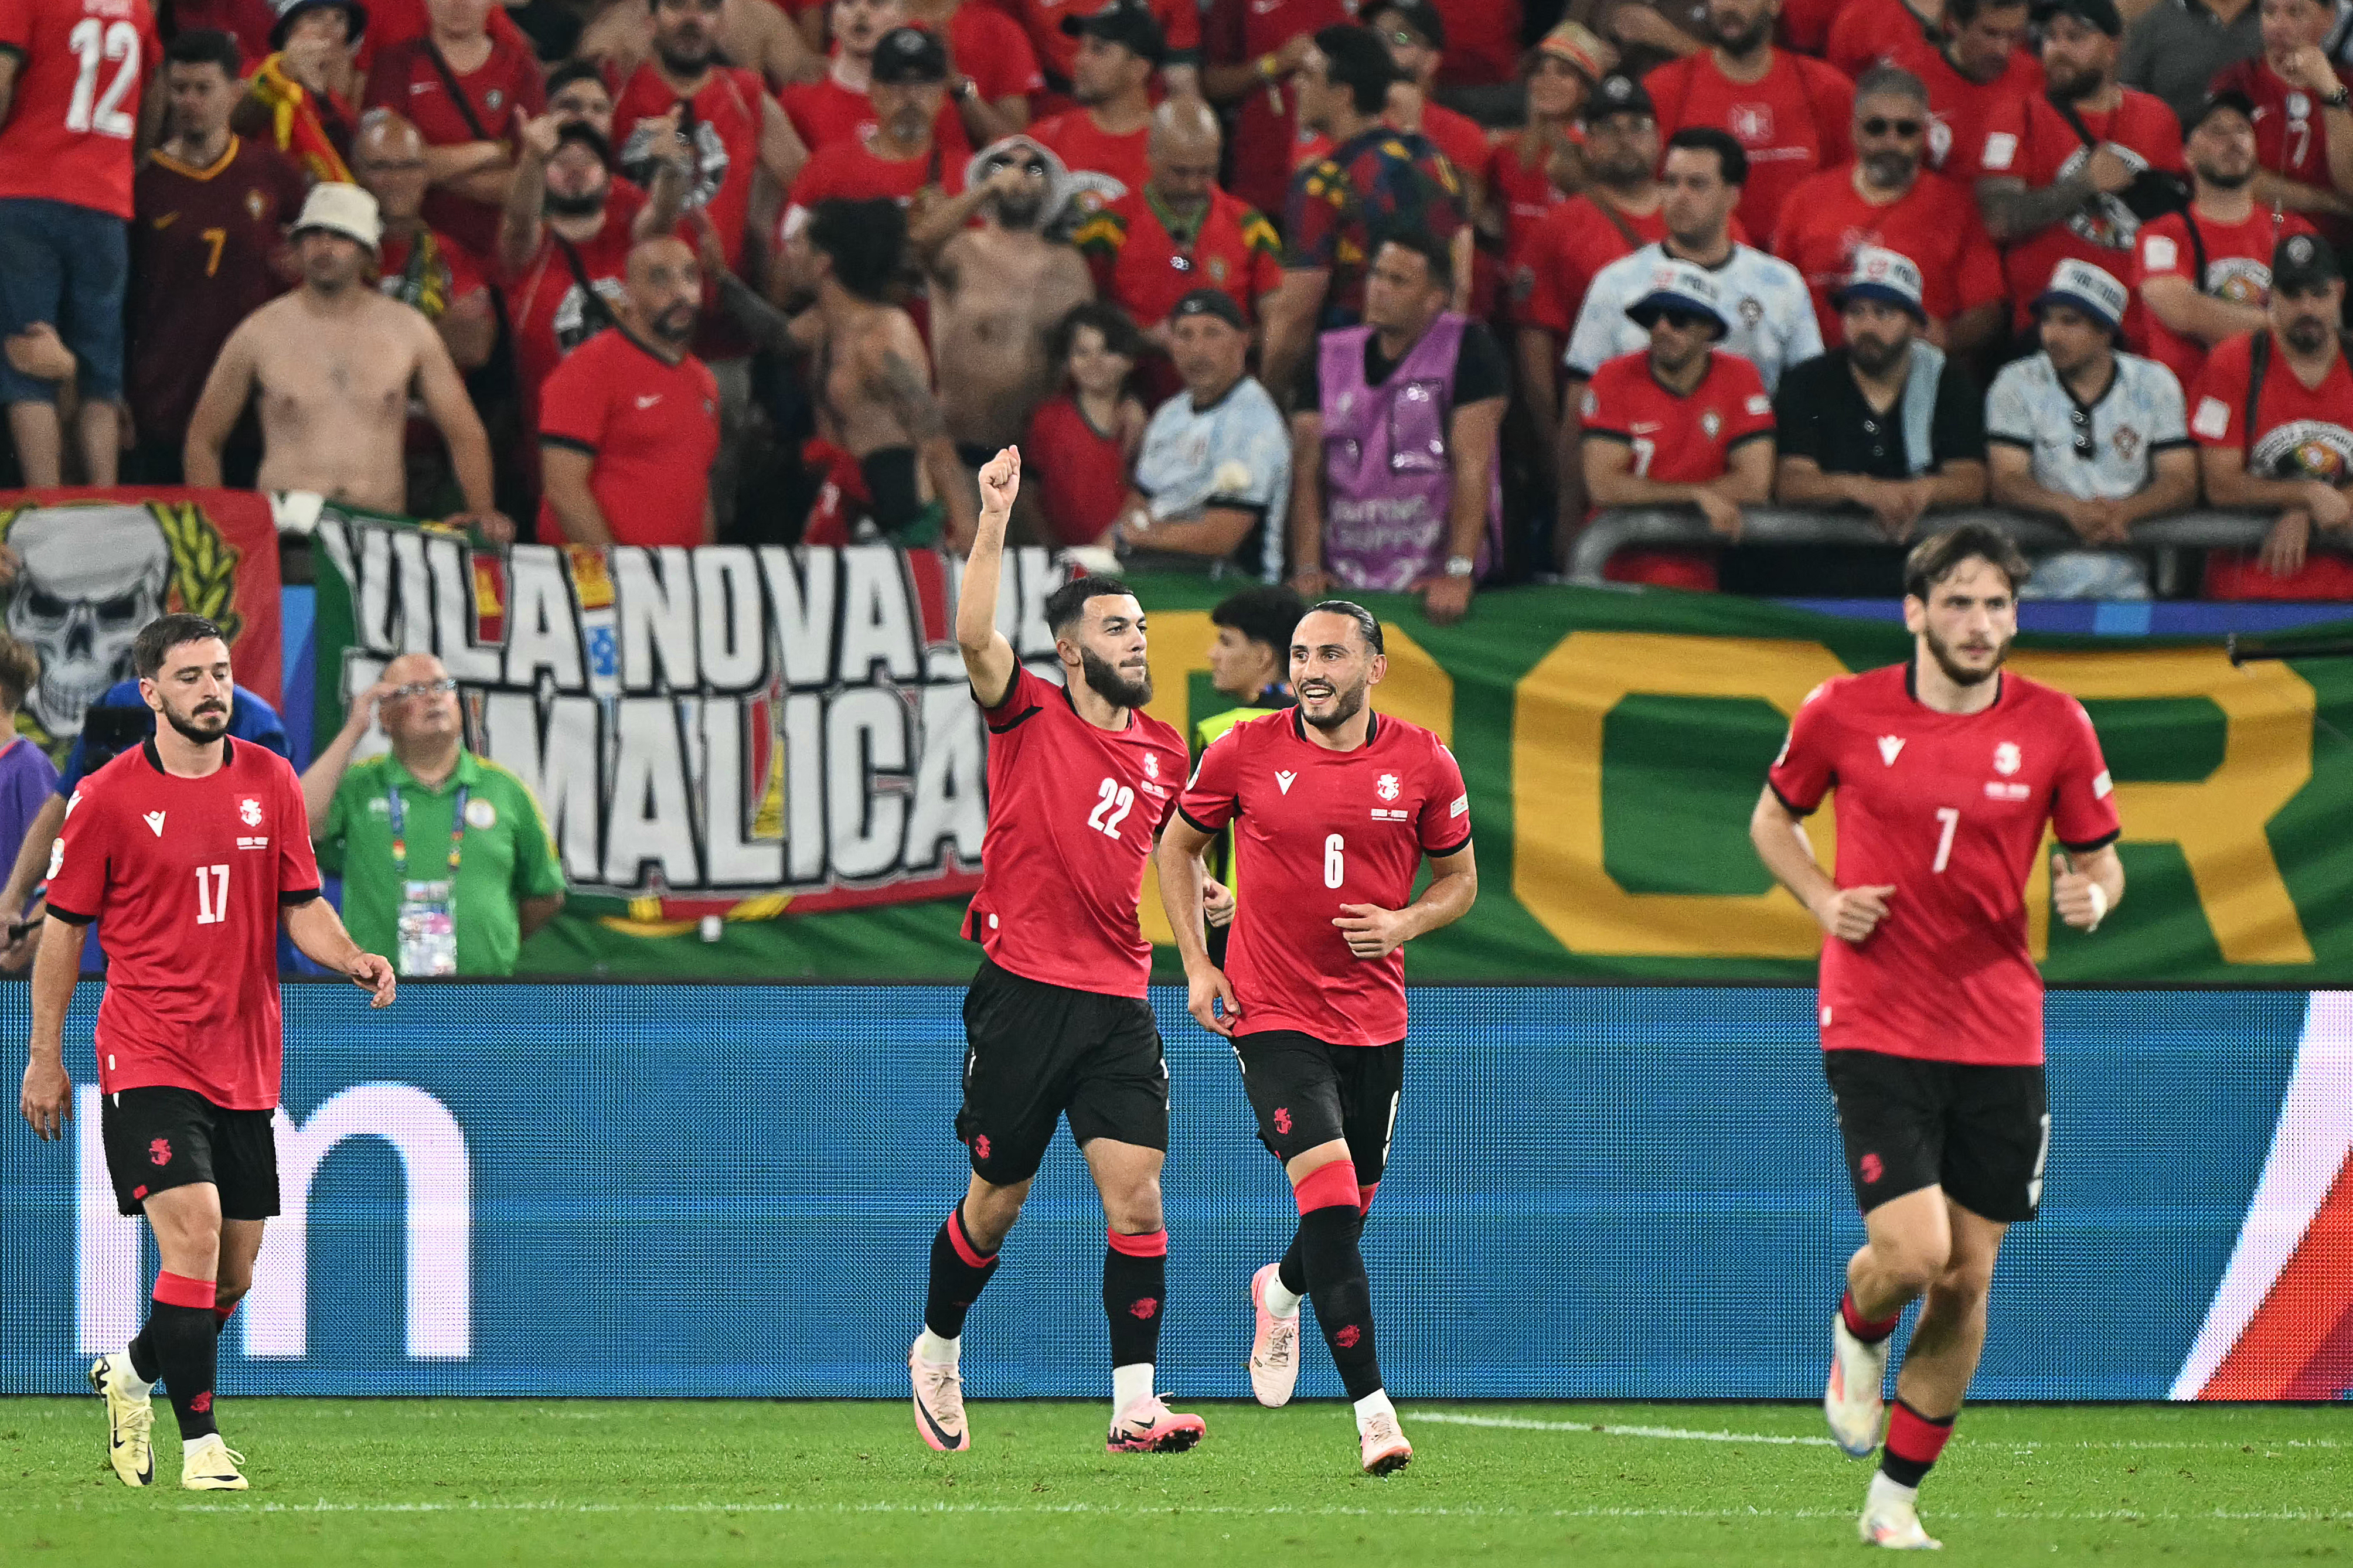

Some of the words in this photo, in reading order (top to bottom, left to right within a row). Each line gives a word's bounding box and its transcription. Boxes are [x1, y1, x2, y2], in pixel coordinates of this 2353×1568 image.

[66, 18, 141, 138] 12
[202, 227, 226, 277] 7
[614, 544, 918, 691] NOVA
[1088, 778, 1135, 840] 22
[1324, 833, 1344, 889] 6
[1932, 808, 1959, 873] 7
[195, 864, 230, 925] 17
